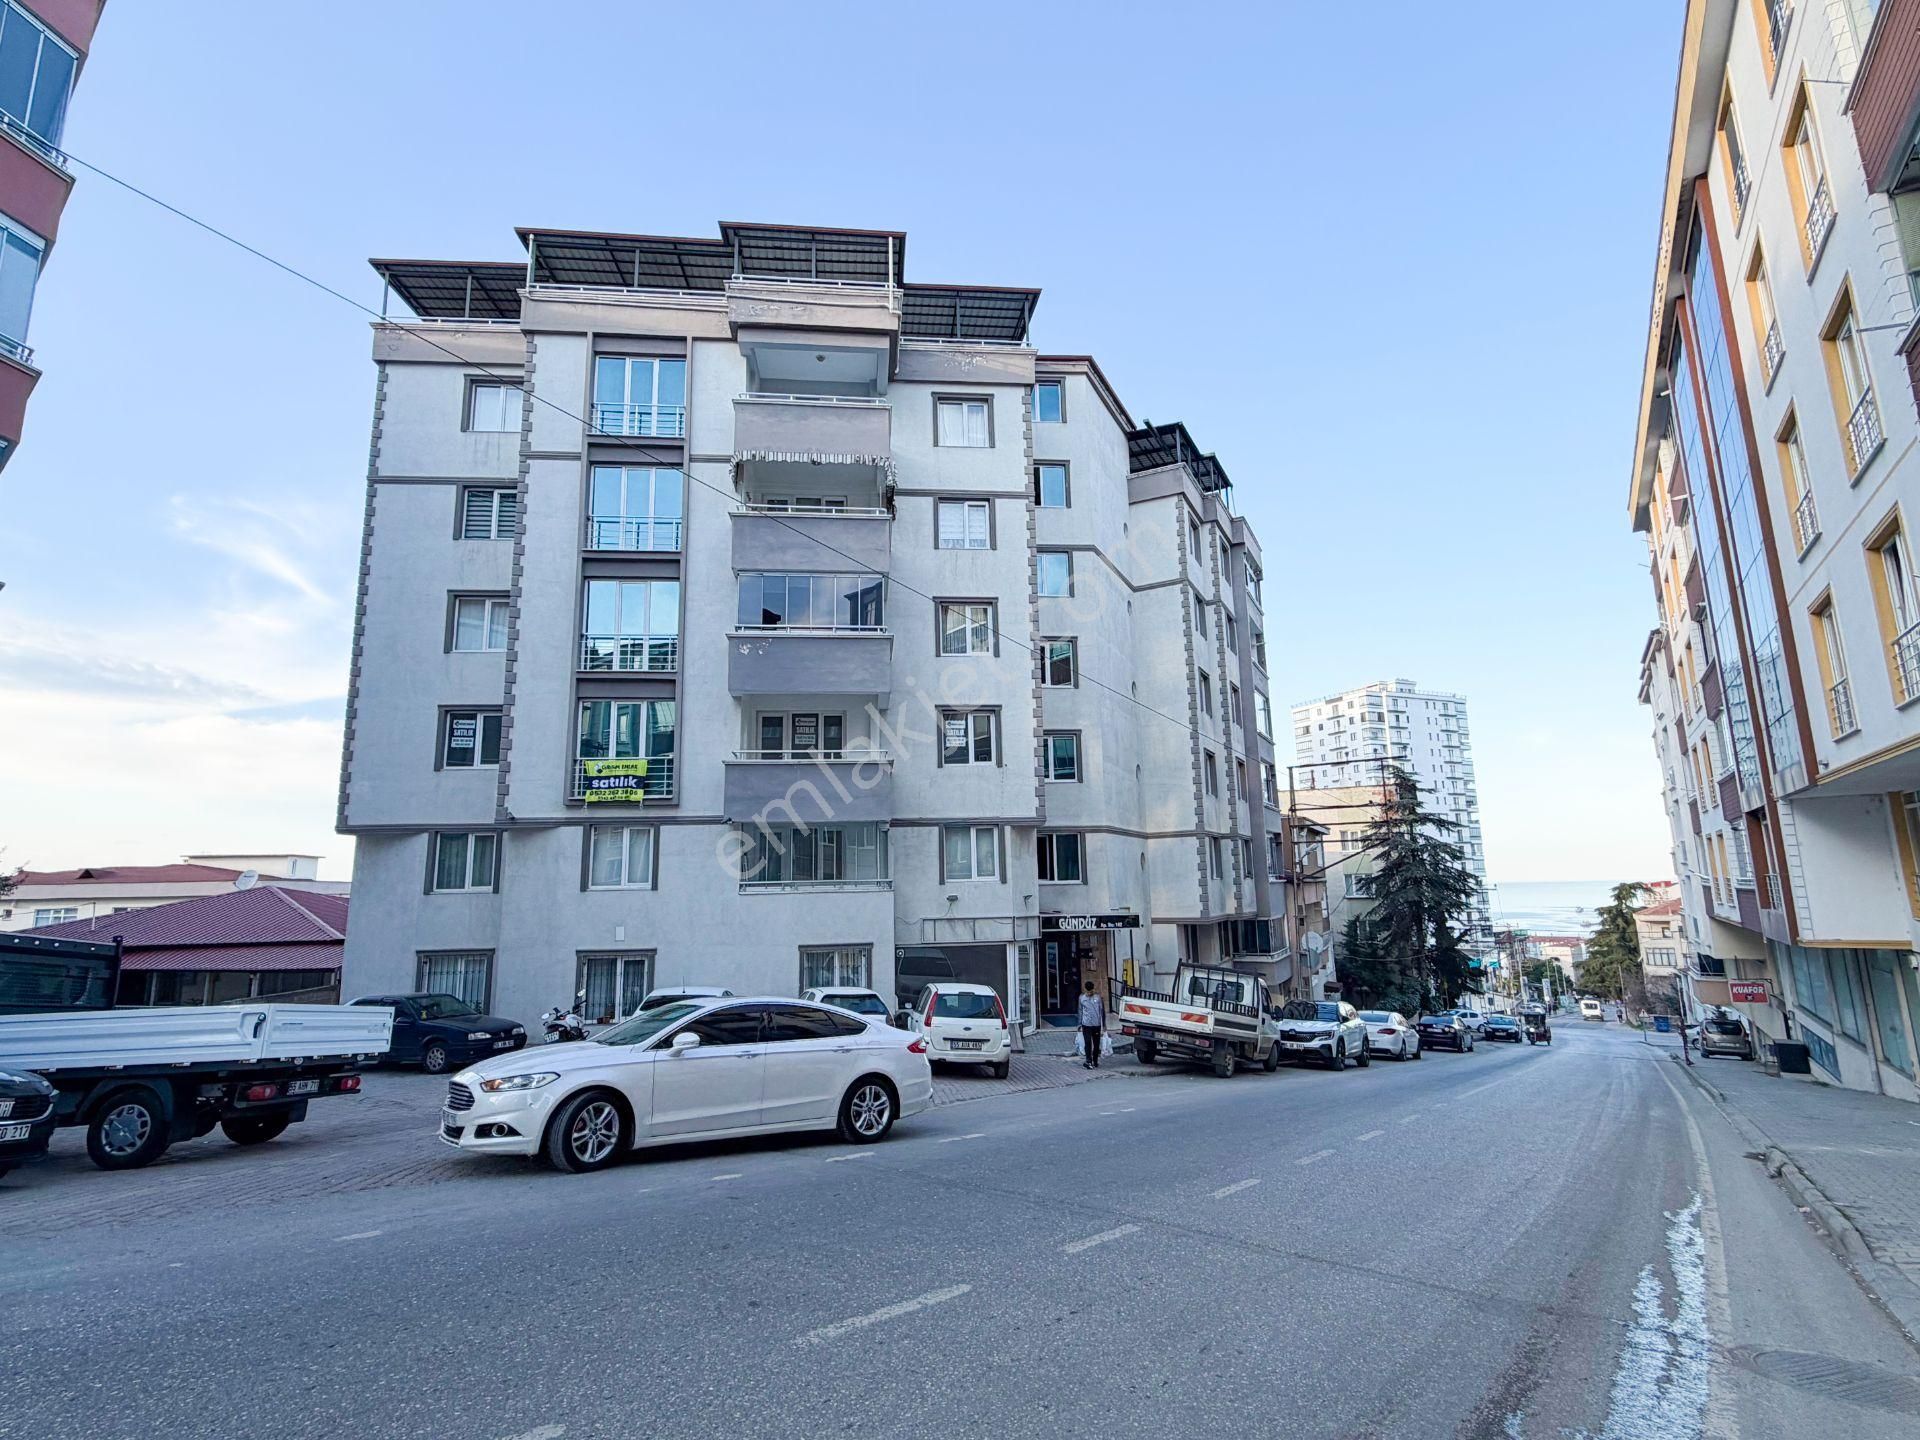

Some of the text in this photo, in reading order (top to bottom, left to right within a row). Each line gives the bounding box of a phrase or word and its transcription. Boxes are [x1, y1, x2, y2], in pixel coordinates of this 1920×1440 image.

[592, 775, 638, 788] satılık
[1058, 914, 1097, 930] GÜNDÜZ
[10, 1125, 30, 1138] 217
